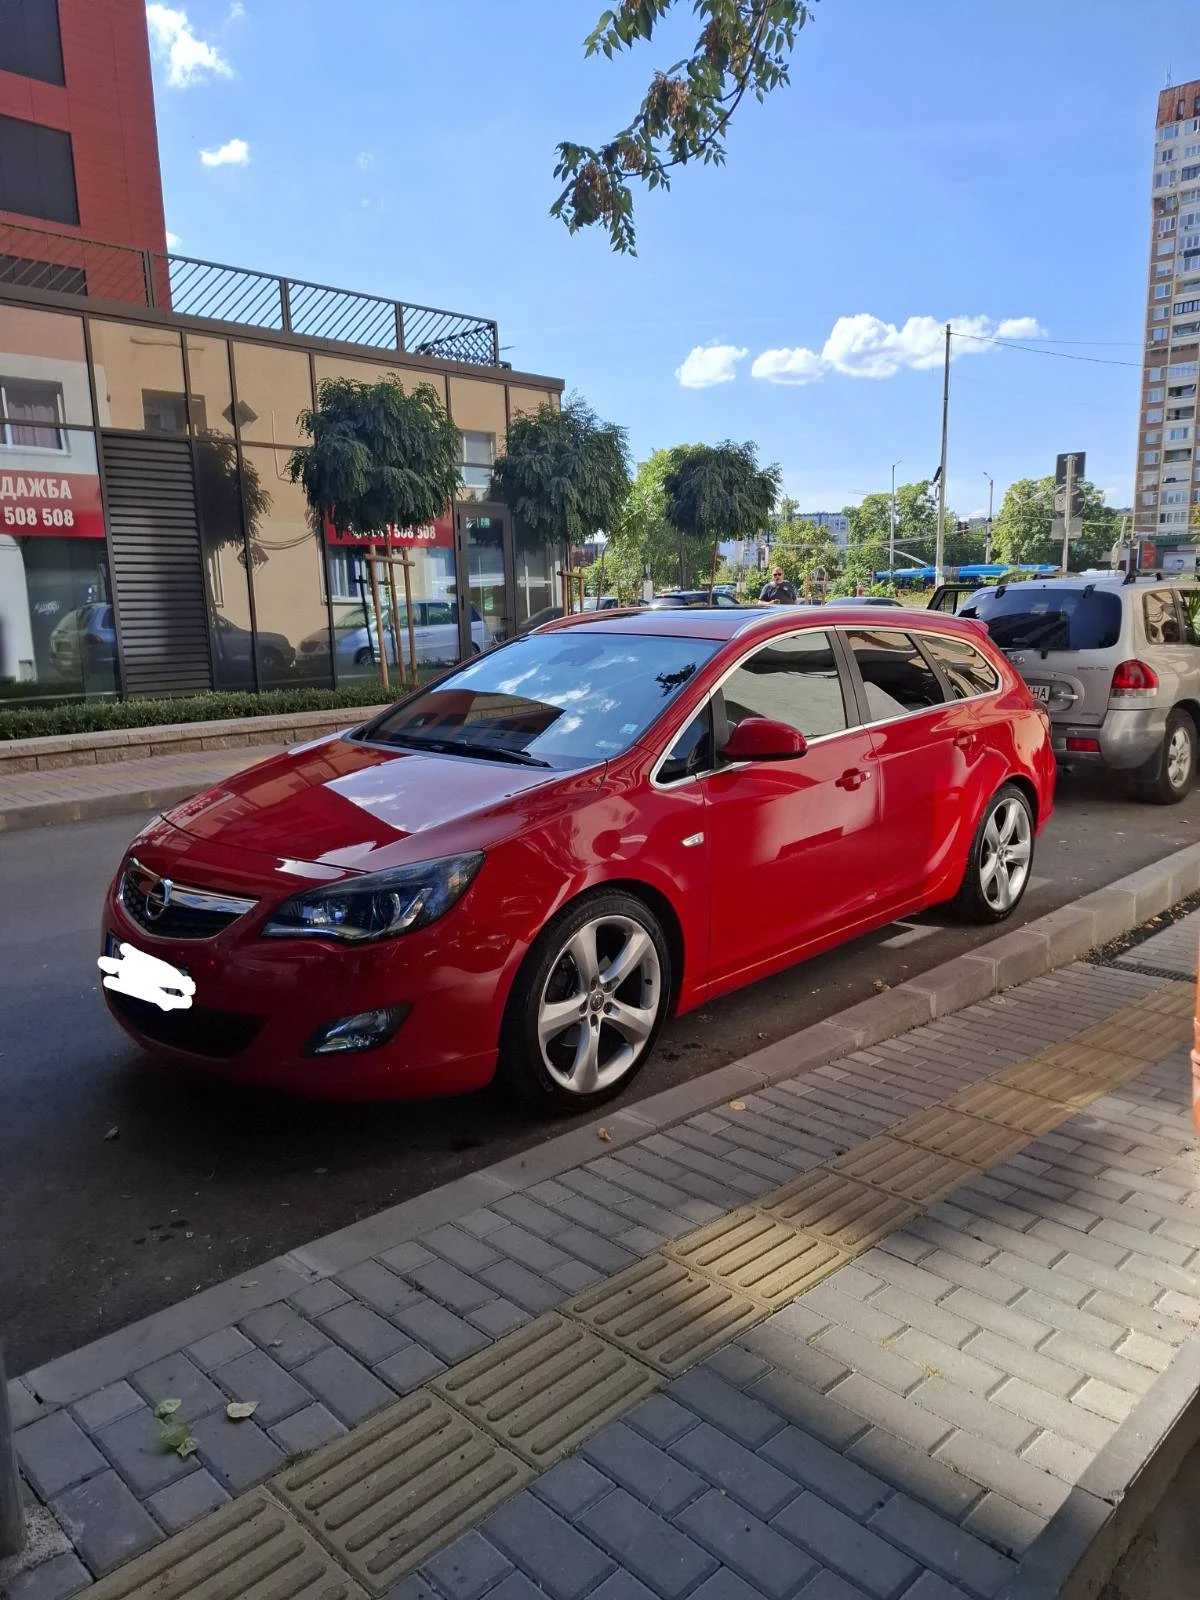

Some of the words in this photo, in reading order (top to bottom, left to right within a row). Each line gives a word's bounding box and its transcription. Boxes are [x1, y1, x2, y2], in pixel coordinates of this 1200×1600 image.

[0, 476, 72, 500] ДАЖБА
[4, 506, 37, 526] 508
[42, 508, 74, 527] 508
